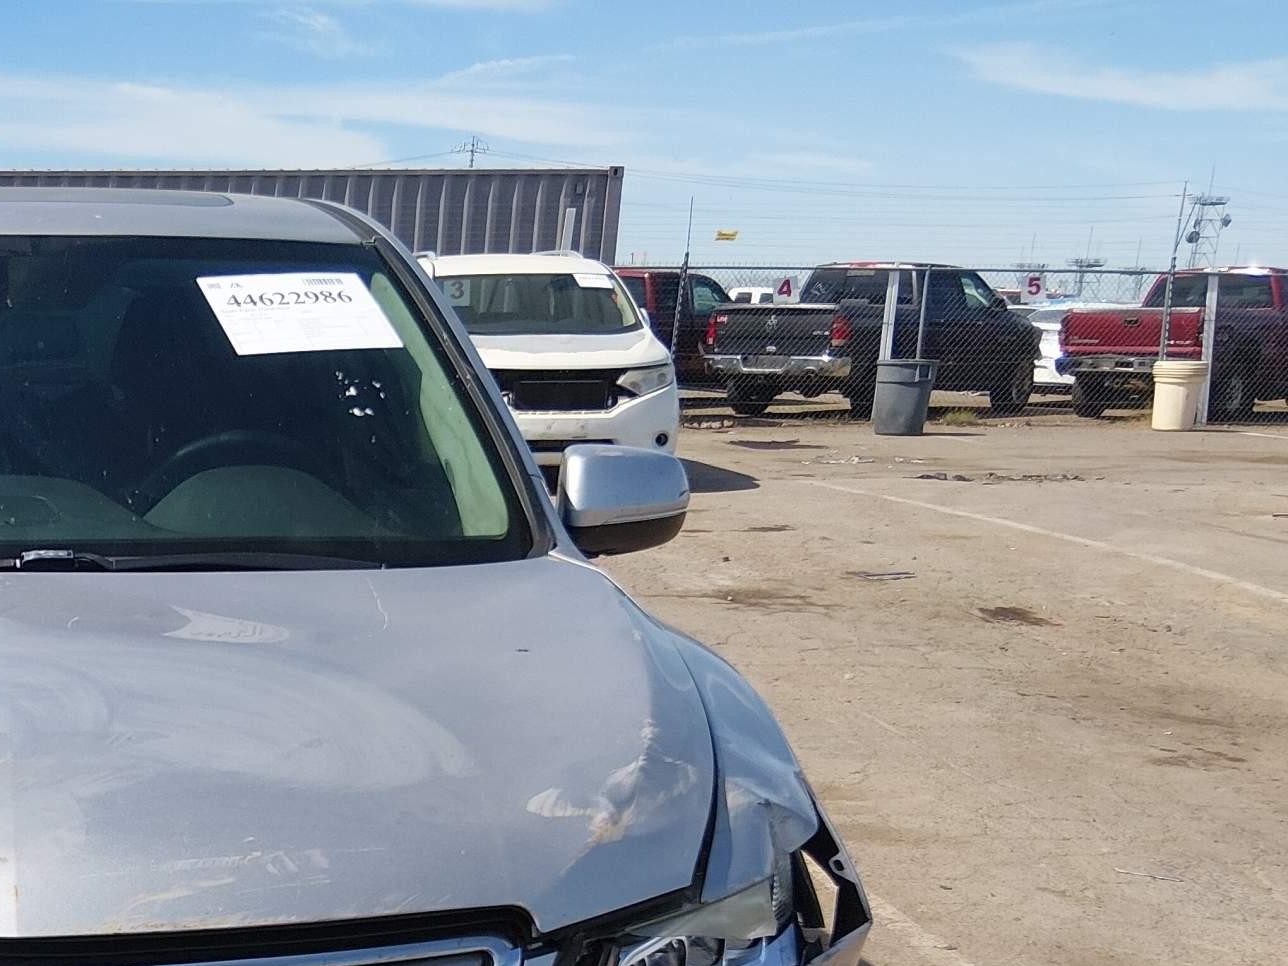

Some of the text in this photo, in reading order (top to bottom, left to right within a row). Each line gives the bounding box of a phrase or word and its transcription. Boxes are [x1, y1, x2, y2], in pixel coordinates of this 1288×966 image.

[450, 281, 464, 299] 3
[777, 279, 792, 296] 4
[1027, 277, 1041, 296] 5
[226, 290, 353, 307] 44622986
